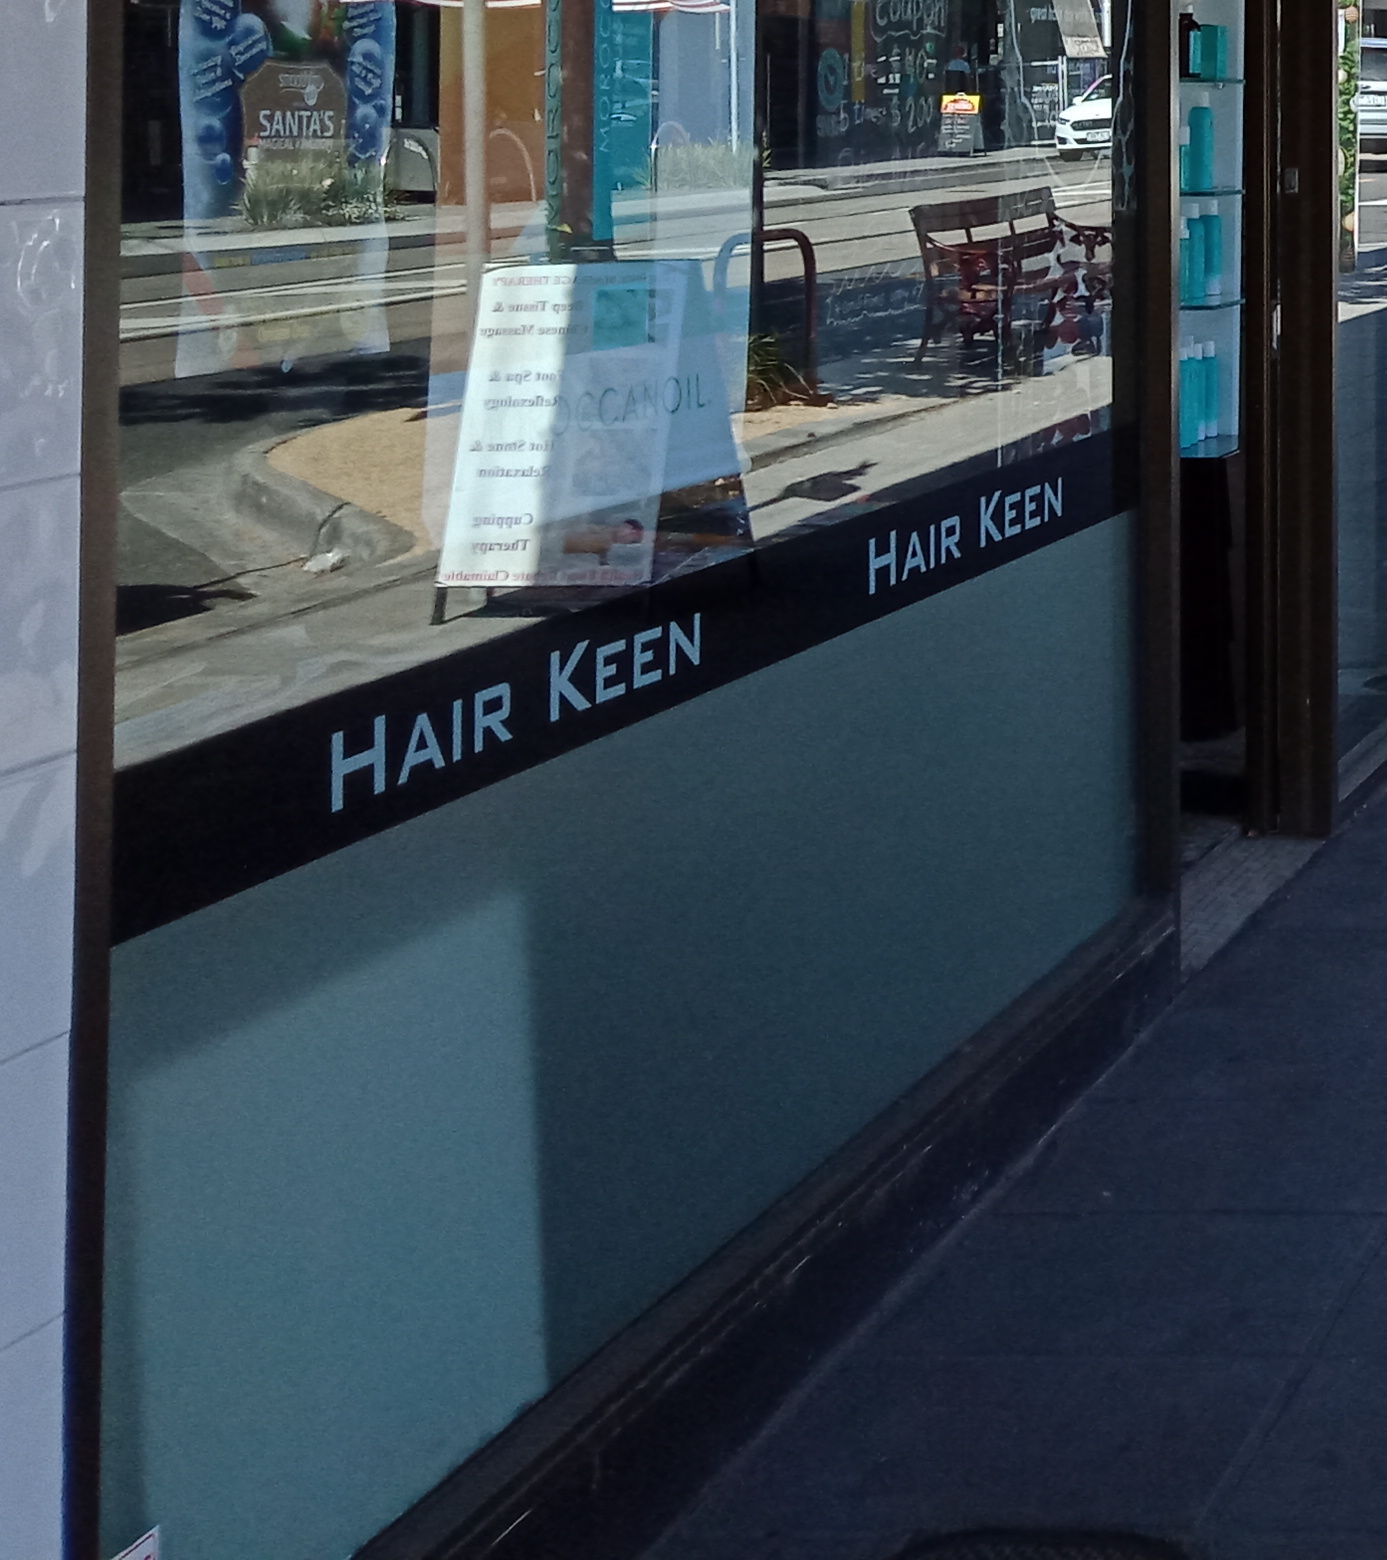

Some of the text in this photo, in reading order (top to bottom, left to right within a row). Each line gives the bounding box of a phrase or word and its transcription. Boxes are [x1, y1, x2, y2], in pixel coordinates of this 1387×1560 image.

[258, 109, 335, 138] SANTA'S
[551, 372, 706, 438] OCCANOIL
[868, 476, 1064, 596] HAIR KEEN
[329, 612, 705, 814] HAIR KEEN
